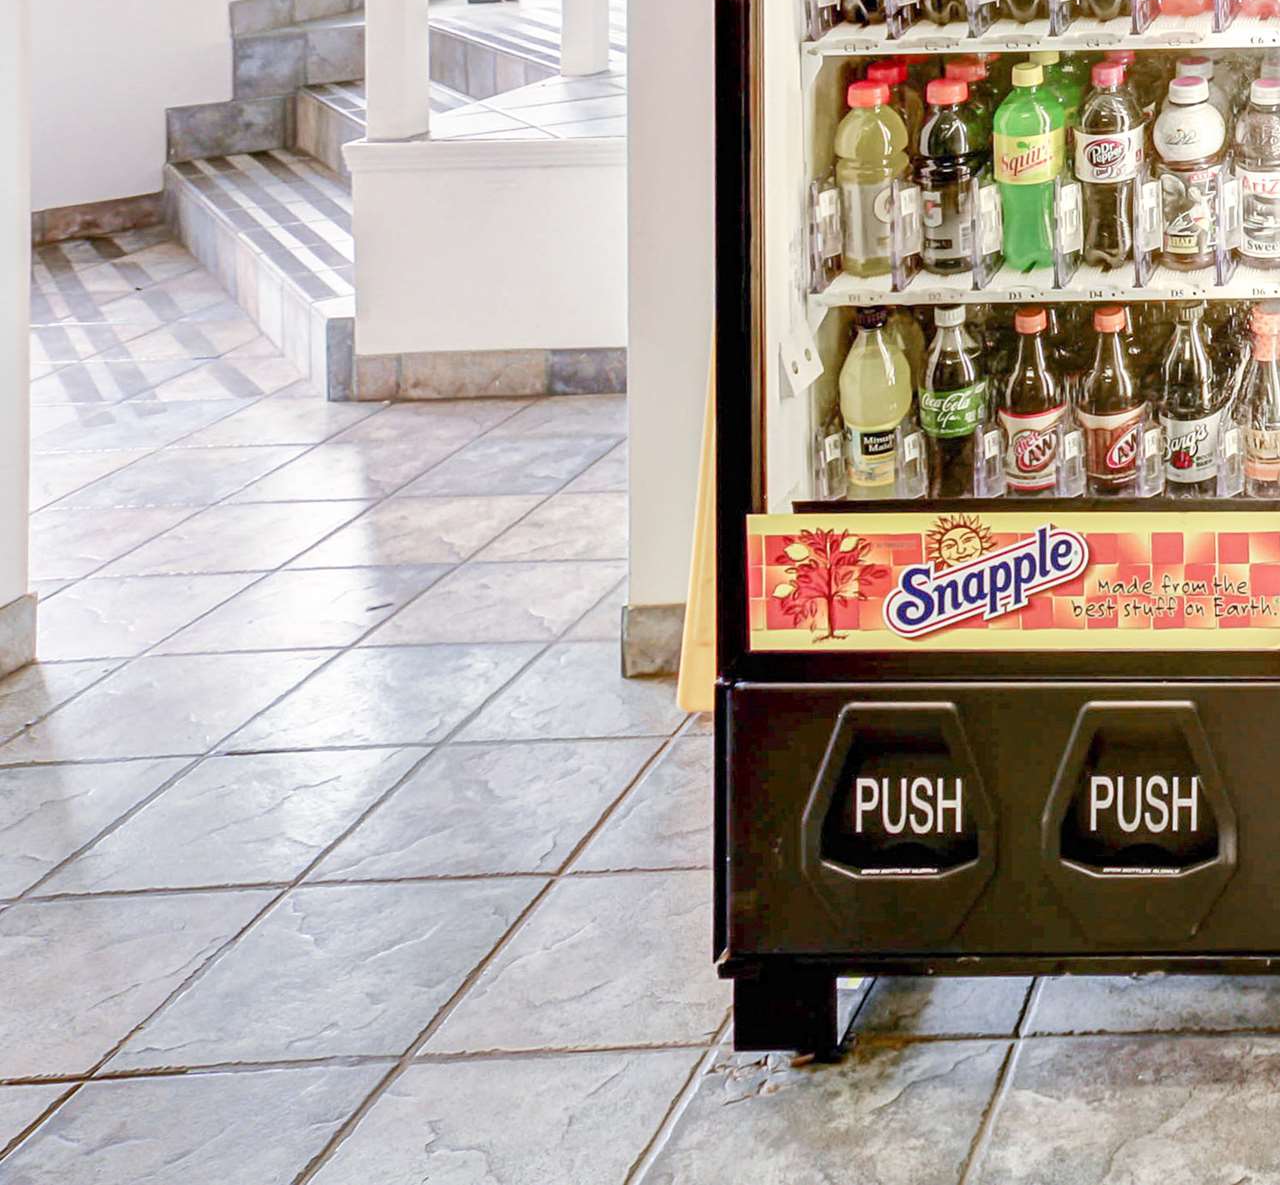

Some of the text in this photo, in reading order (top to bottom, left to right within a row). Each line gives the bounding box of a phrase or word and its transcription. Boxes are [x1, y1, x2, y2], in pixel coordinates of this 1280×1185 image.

[1001, 145, 1048, 176] Squir
[899, 525, 1073, 626] Snapple
[1098, 573, 1248, 594] Made from the
[1072, 600, 1116, 617] best
[1124, 598, 1177, 617] stuff
[1185, 603, 1205, 615] on
[855, 777, 963, 834] PUSH
[1089, 775, 1198, 833] PUSH
